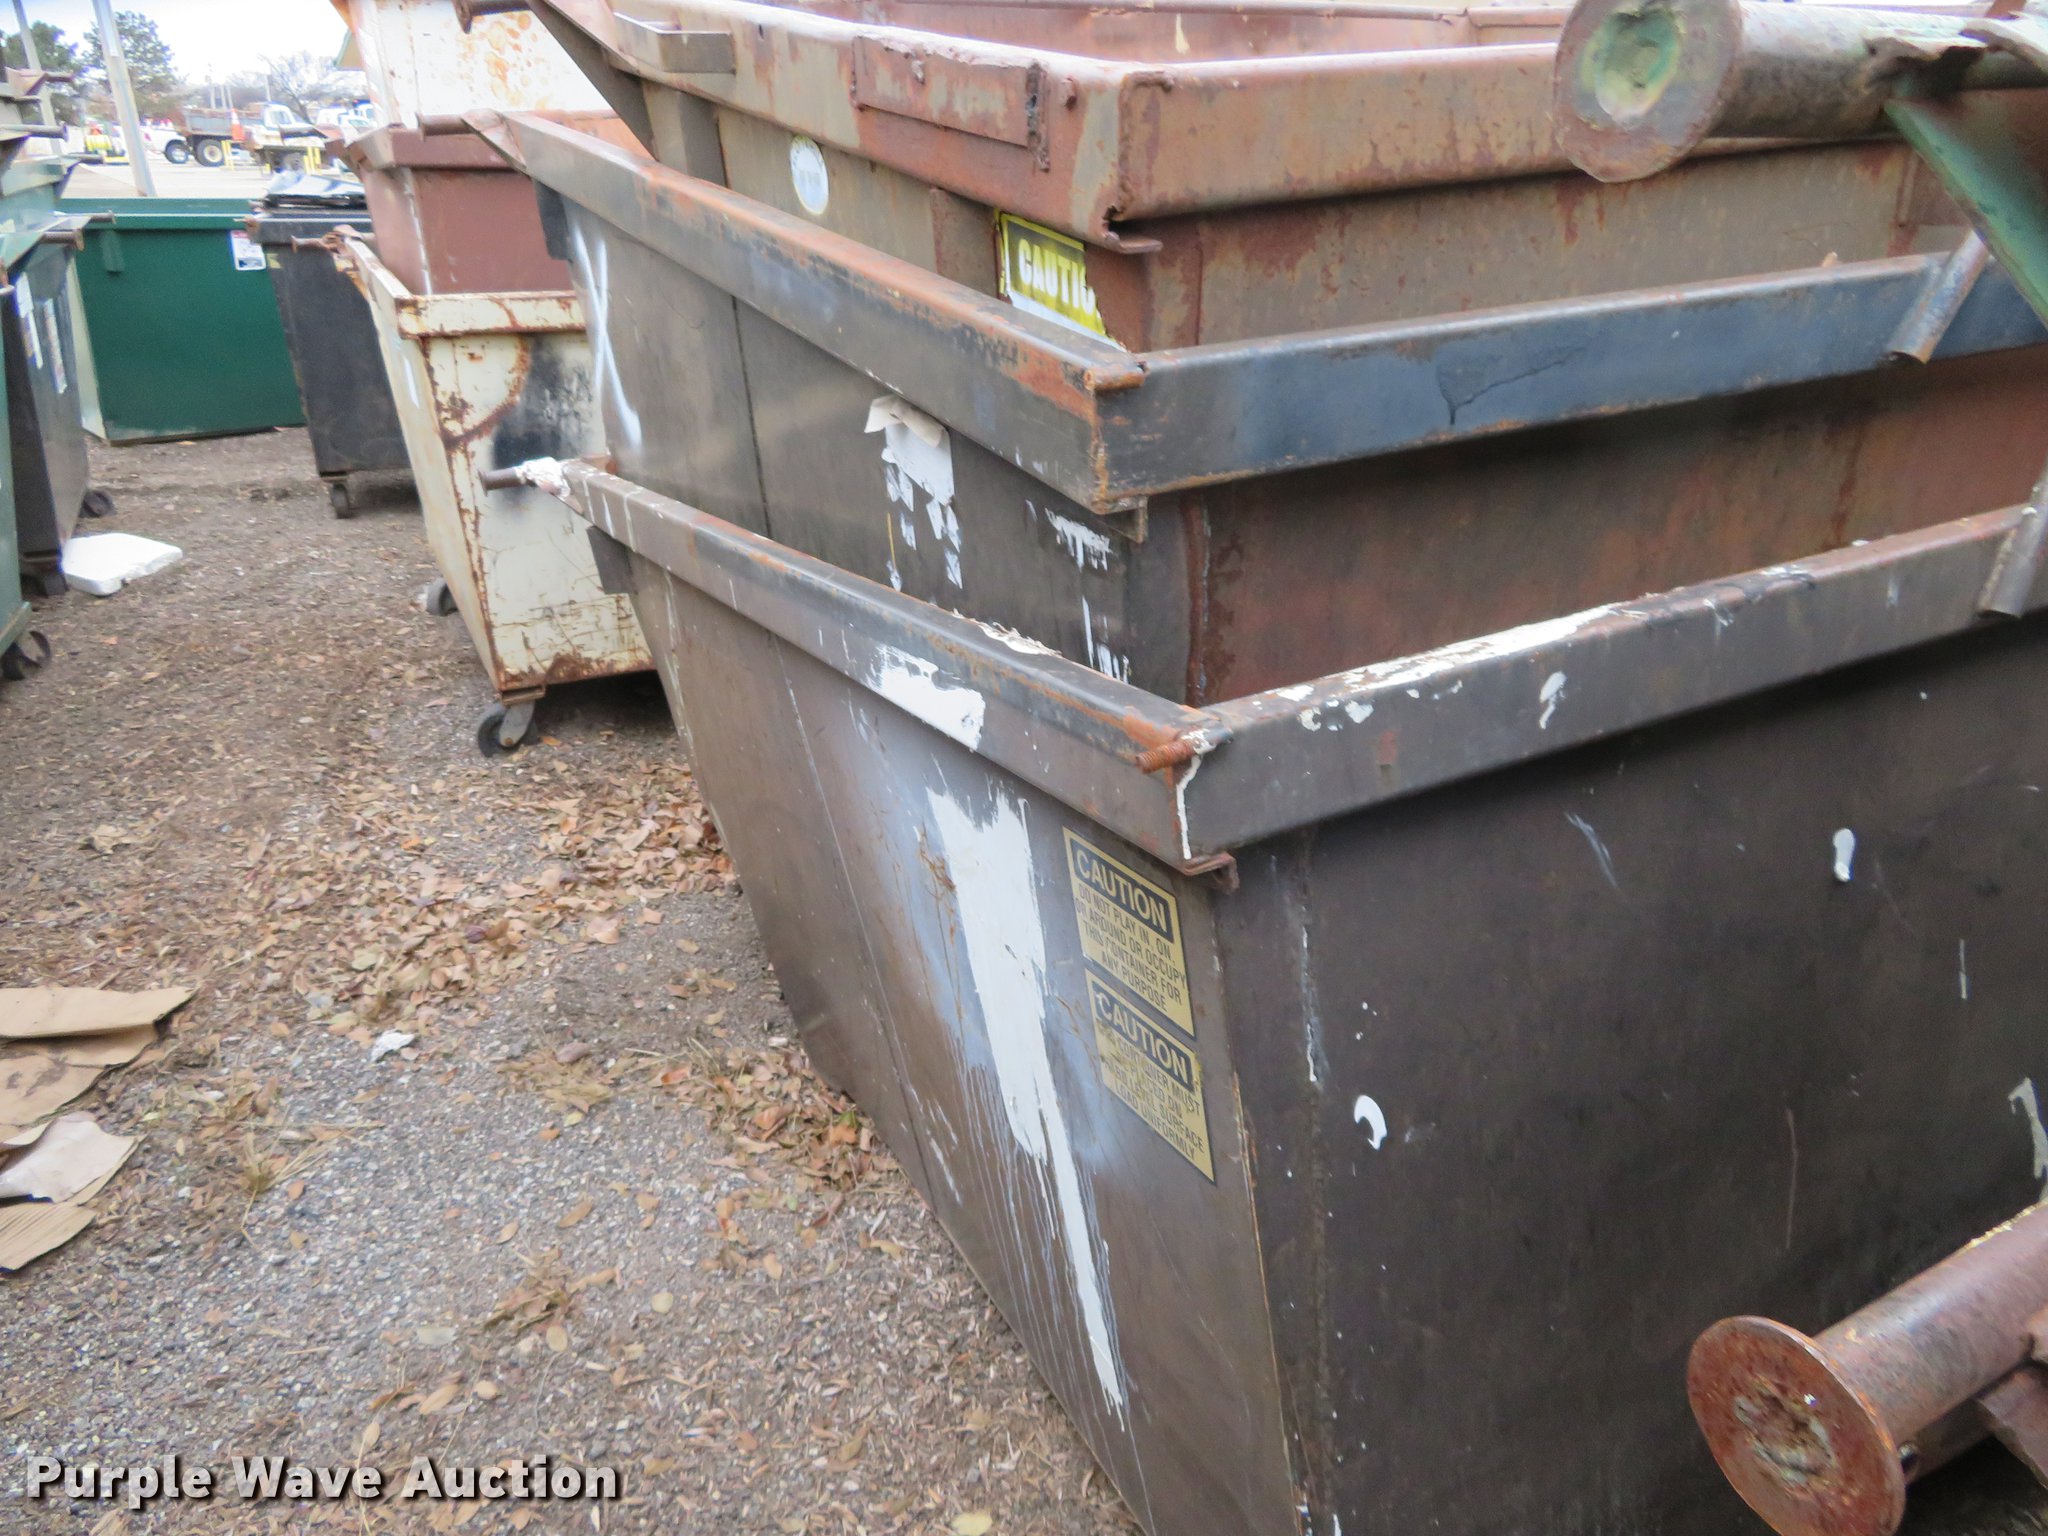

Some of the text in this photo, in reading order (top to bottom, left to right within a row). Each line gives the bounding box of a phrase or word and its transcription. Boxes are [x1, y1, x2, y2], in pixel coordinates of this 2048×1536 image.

[1075, 846, 1167, 933] CAUTION
[1077, 882, 1091, 904] DO
[1092, 892, 1111, 918] NOT
[1112, 905, 1137, 937] PLAY
[1074, 895, 1187, 991] OR AROUND OR OCCUPY
[1082, 918, 1181, 1005] THIS CONTAINER FOR
[1100, 949, 1167, 1012] ANY PURPOSE
[1096, 988, 1188, 1084] CAUTION
[1114, 1077, 1196, 1163] LOAD UNIFORMLY
[1158, 1101, 1204, 1154] SURFACE
[1170, 1080, 1201, 1119] MUST
